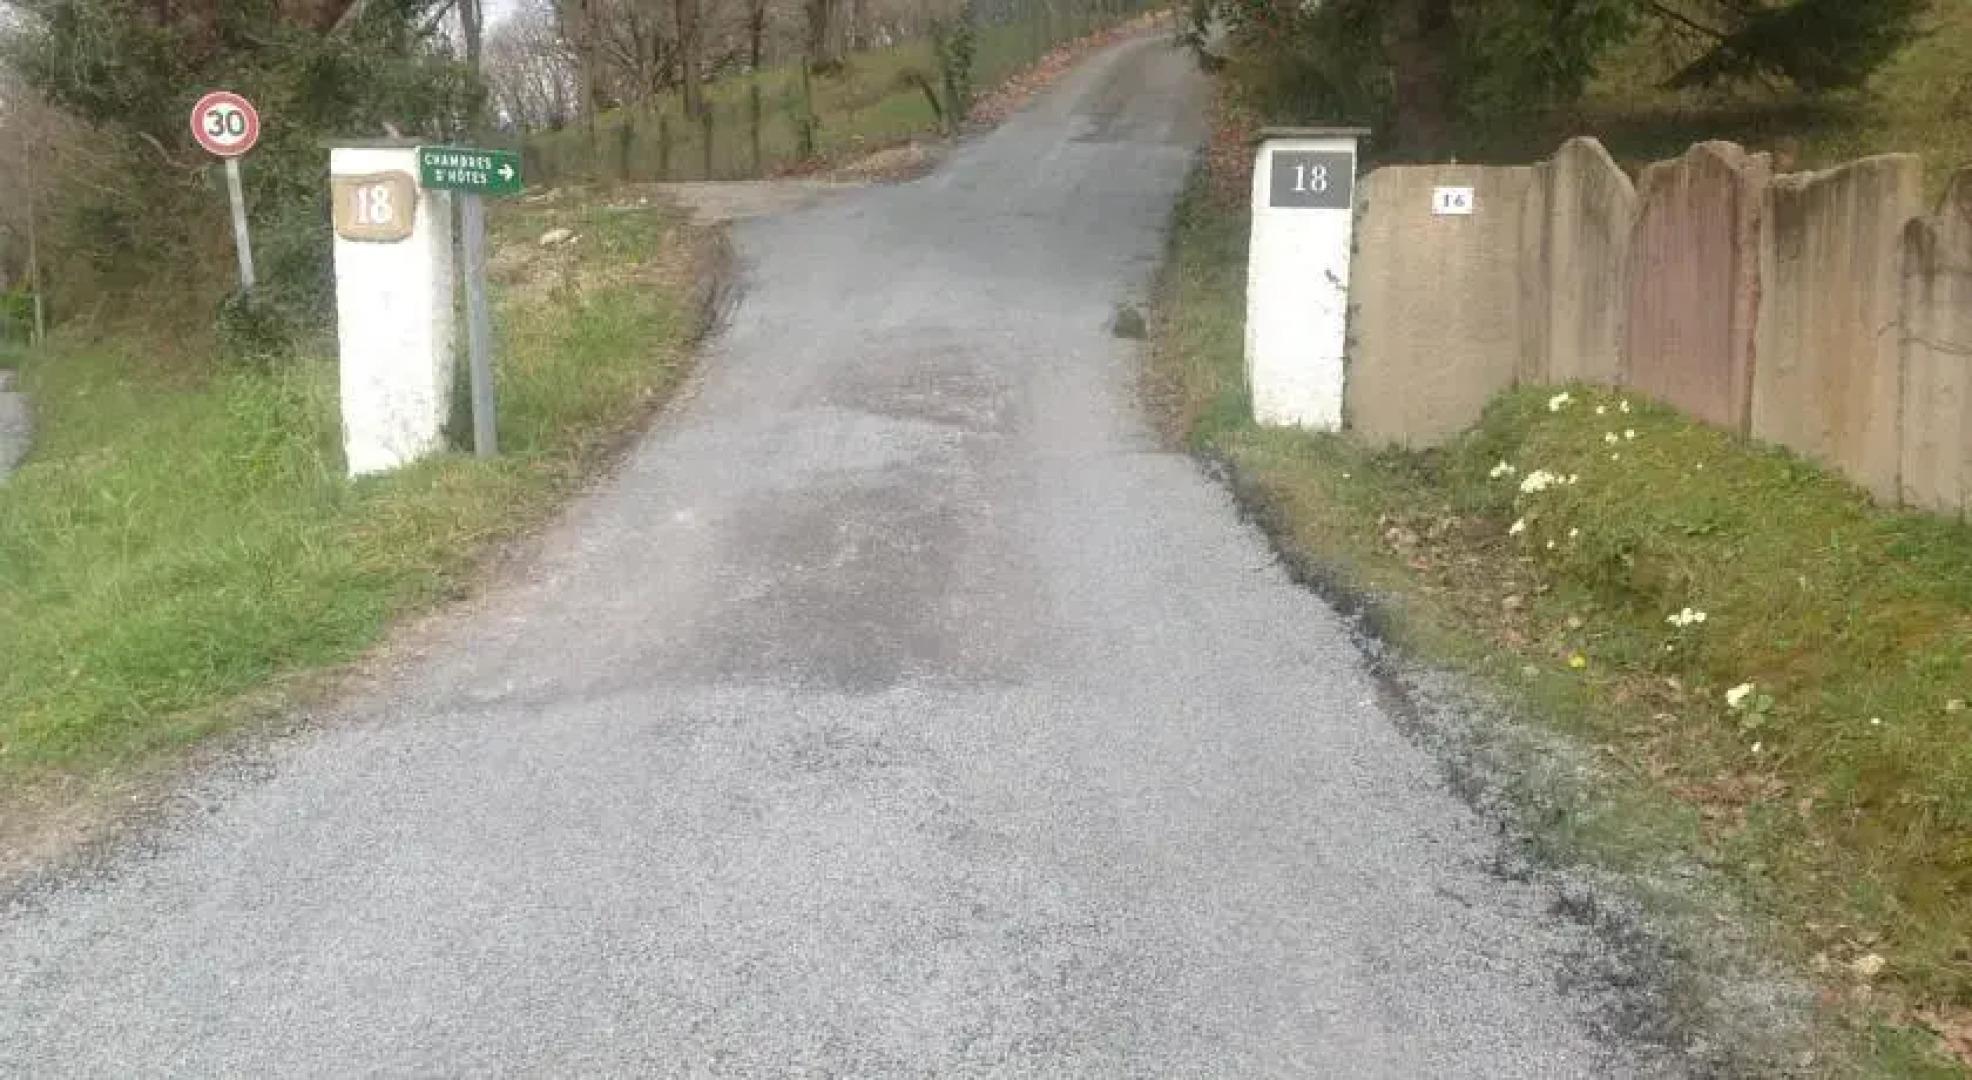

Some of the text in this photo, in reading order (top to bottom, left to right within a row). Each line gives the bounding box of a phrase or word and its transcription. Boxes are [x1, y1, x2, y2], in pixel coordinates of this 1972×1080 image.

[206, 109, 245, 136] 30
[424, 152, 491, 170] CHAMBRES
[1293, 164, 1328, 191] 18
[356, 185, 393, 224] 18
